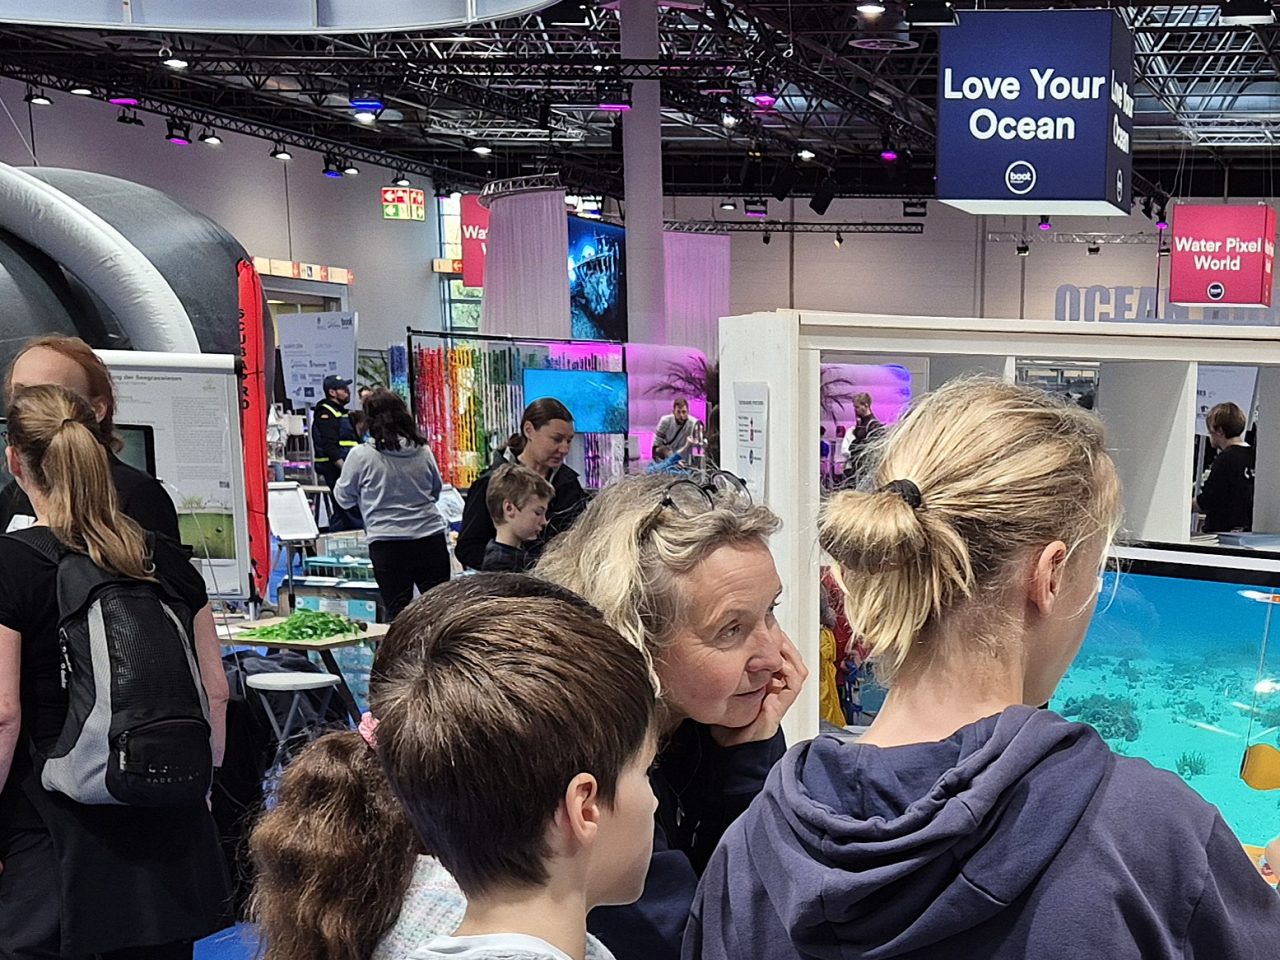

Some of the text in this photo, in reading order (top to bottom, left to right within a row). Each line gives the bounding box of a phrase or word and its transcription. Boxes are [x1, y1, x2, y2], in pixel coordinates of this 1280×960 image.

[944, 68, 1106, 100] Love Your
[969, 108, 1075, 140] Ocean
[1010, 171, 1032, 182] boot
[1175, 237, 1222, 253] Water
[1226, 237, 1262, 253] Pixel
[1194, 255, 1241, 271] World
